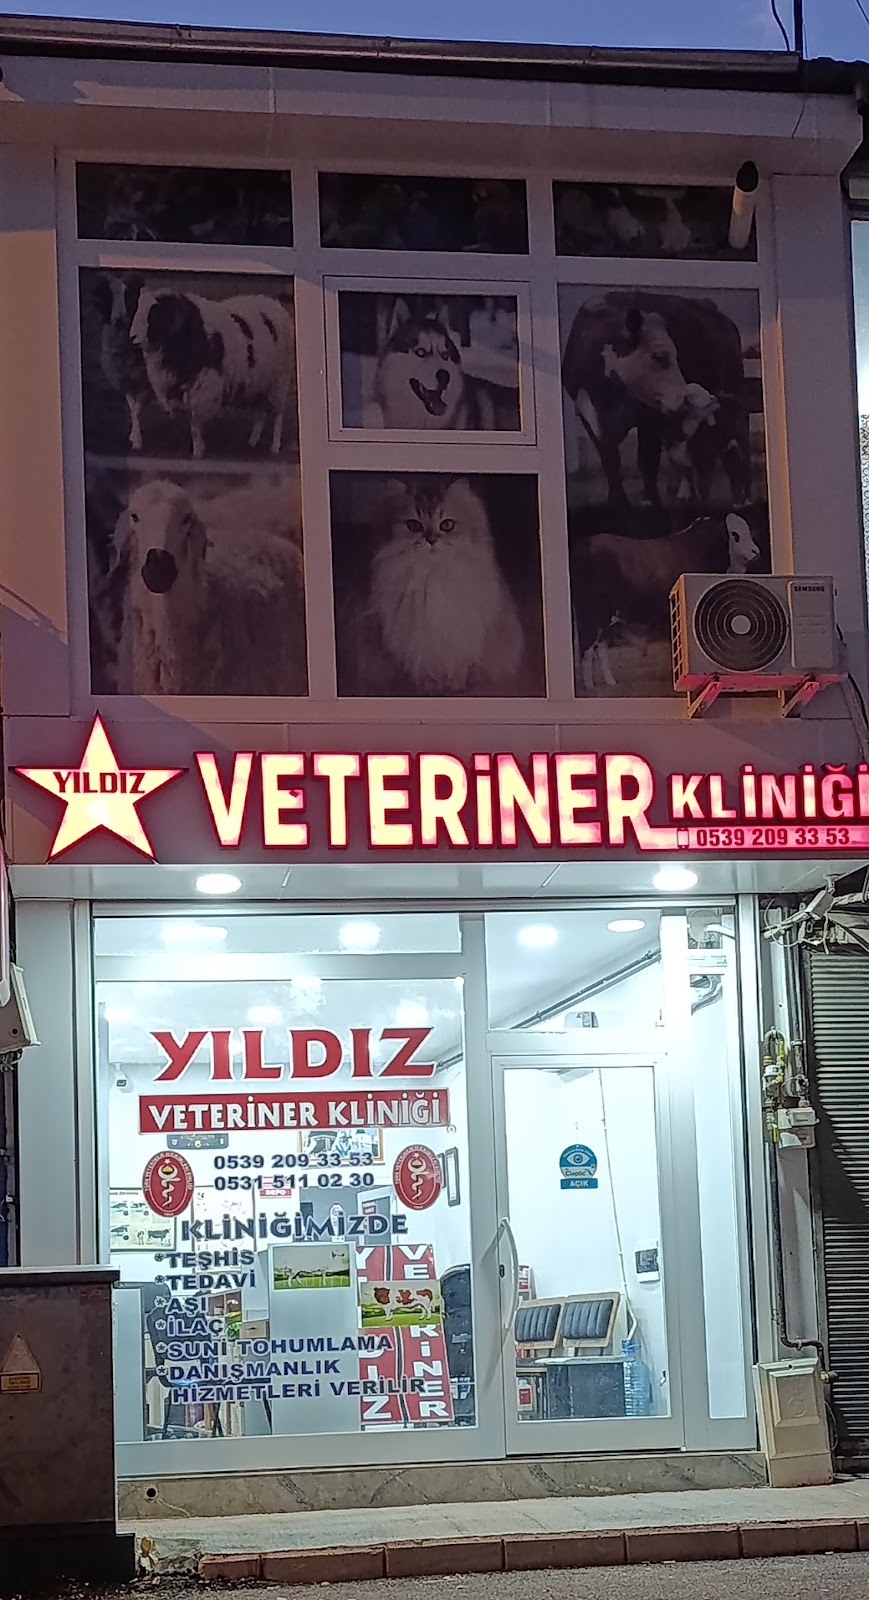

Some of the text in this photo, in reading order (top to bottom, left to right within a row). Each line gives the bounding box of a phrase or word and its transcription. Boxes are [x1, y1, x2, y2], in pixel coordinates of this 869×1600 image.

[52, 771, 146, 794] YILDIZ
[696, 827, 850, 846] 0539 209 33 53
[149, 1027, 435, 1082] YILDIZ
[147, 1090, 442, 1131] VETERİNER KLİNİĞİ
[213, 1151, 374, 1170] 0539 209 33 53
[213, 1172, 375, 1191] 0531 511 02 30
[569, 1179, 590, 1188] AÇIK
[181, 1211, 409, 1242] KLİNİĞİMİZDE
[237, 1335, 393, 1356] TOHUMLAMA
[170, 1359, 341, 1381] DANIŞMANLIK
[172, 1378, 321, 1403] HİZMETLERİ
